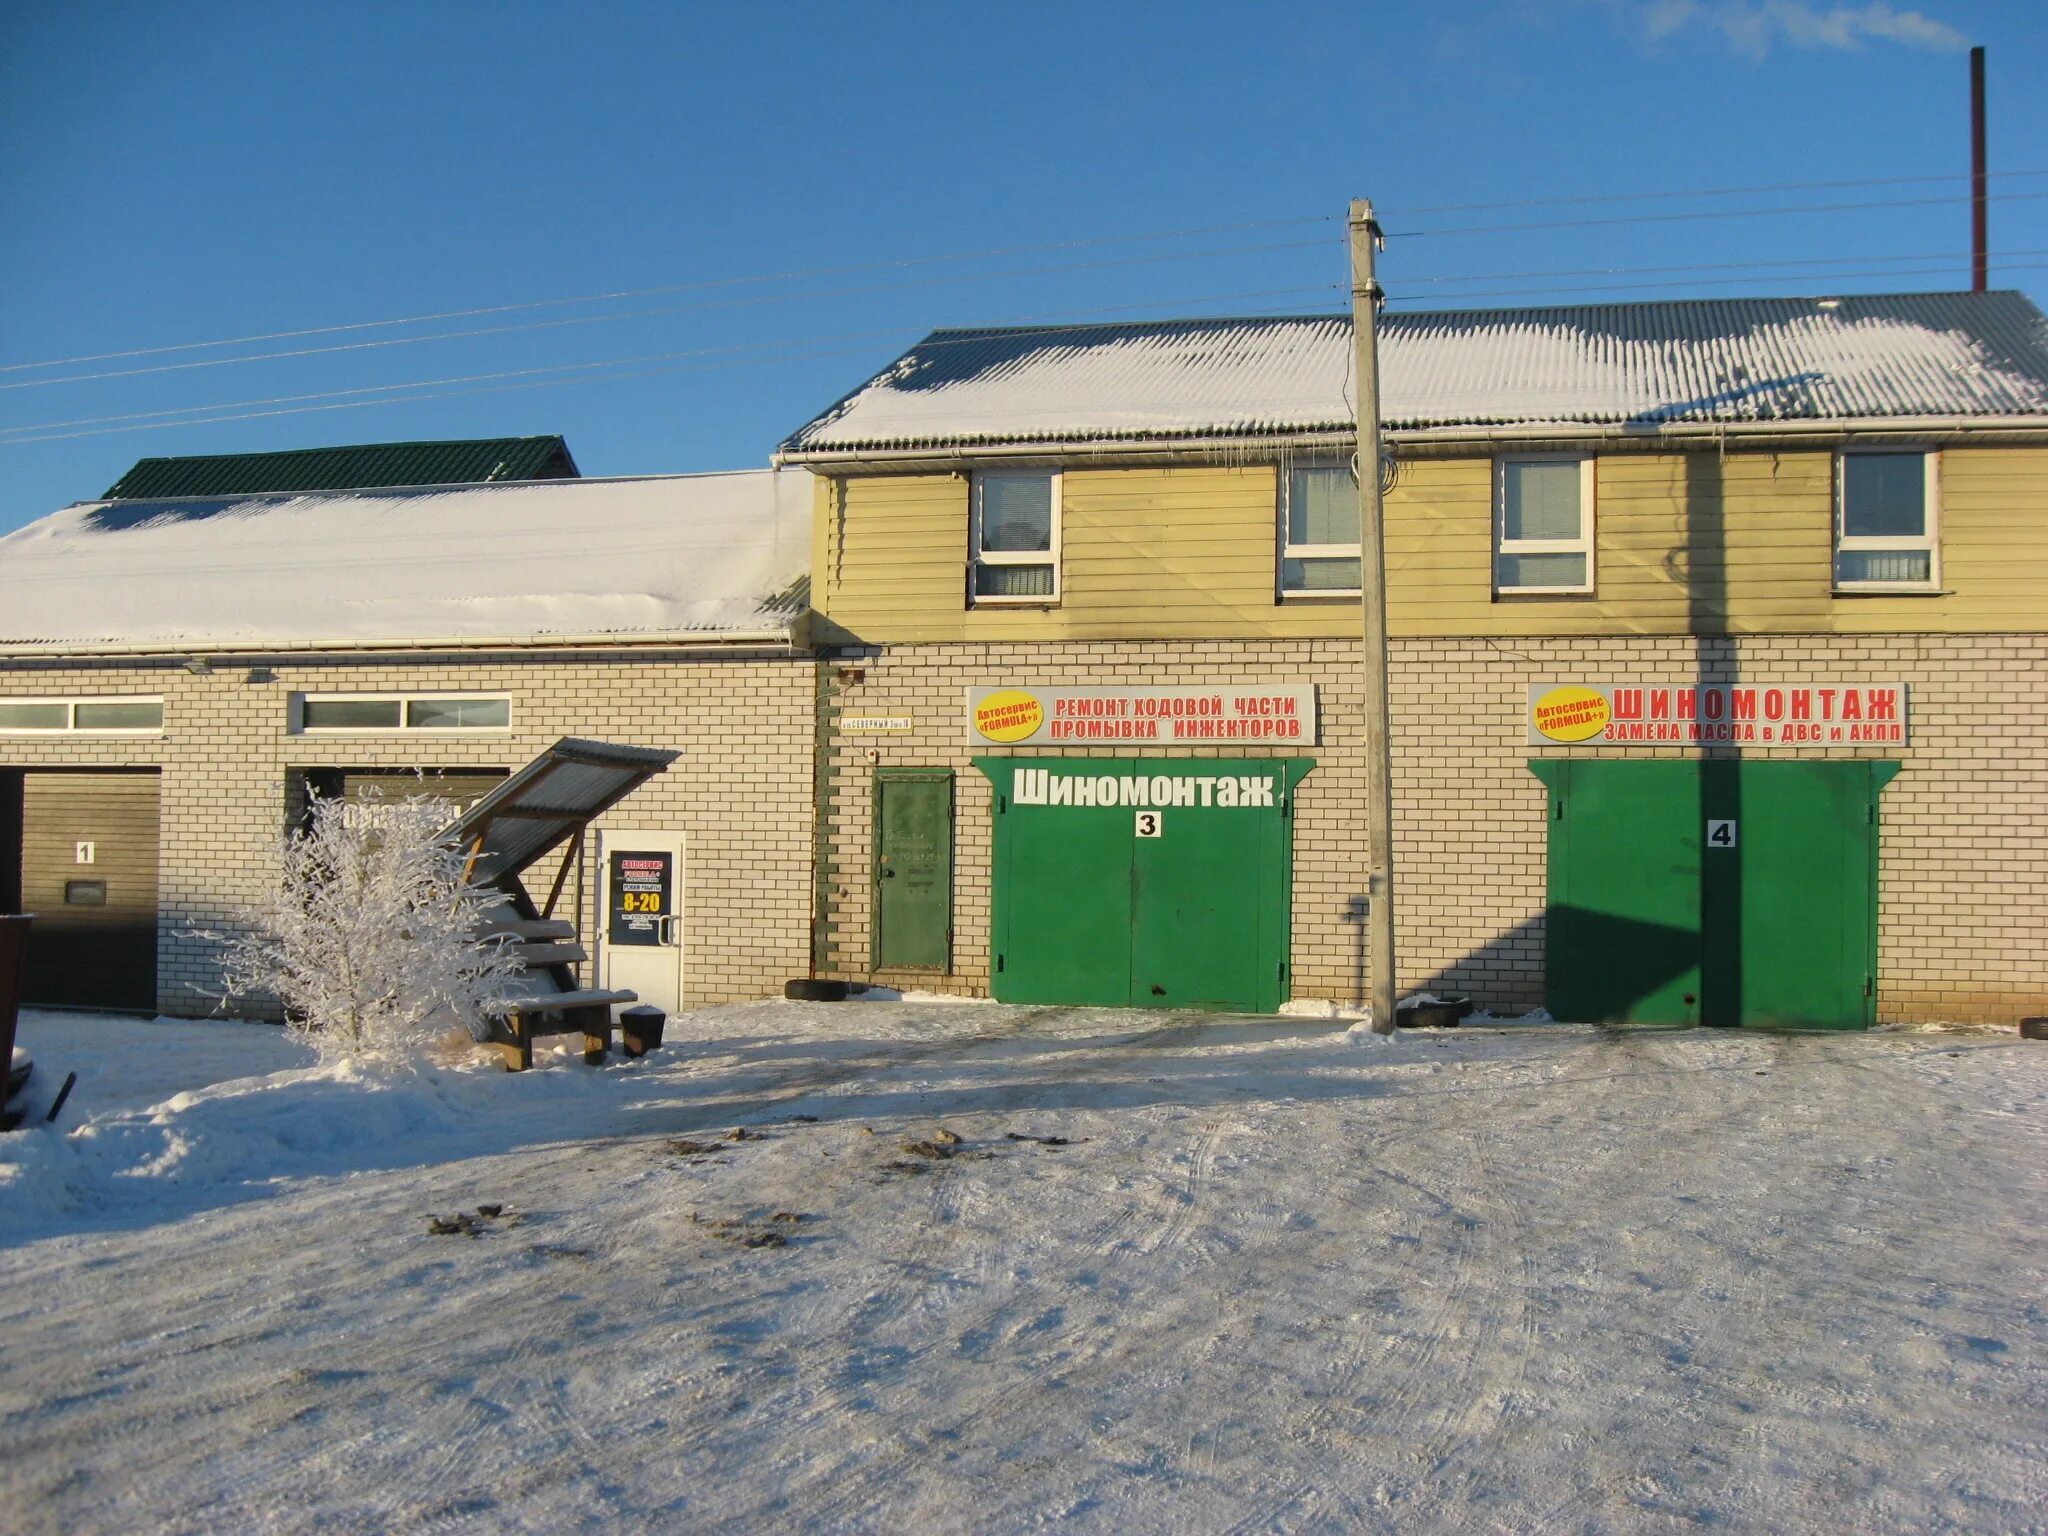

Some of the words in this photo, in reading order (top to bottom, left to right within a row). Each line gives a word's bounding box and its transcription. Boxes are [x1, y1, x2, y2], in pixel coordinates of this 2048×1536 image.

[977, 700, 1038, 721] Автосервис
[1055, 697, 1129, 717] РЕМОНТ
[1133, 694, 1223, 719] ХОДОВОЙ
[1233, 696, 1296, 716] ЧАСТИ
[1536, 697, 1604, 719] Автосервис
[1613, 688, 1897, 721] ШИНОМОНТАЖ
[1050, 720, 1158, 739] ПРОМЫВКА
[1173, 719, 1300, 738] ИНЖЕКТОРОВ
[1603, 722, 1683, 742] ЗАМЕНА
[1688, 722, 1756, 742] МАСЛА
[1761, 726, 1774, 742] в
[1780, 722, 1822, 743] ДВС
[1829, 726, 1841, 742] и
[1849, 722, 1902, 742] АКПП
[1013, 768, 1274, 807] Шиномонтаж
[1140, 814, 1156, 836] 3
[1711, 823, 1732, 846] 4
[79, 844, 89, 862] 1
[624, 893, 660, 912] 8-20
